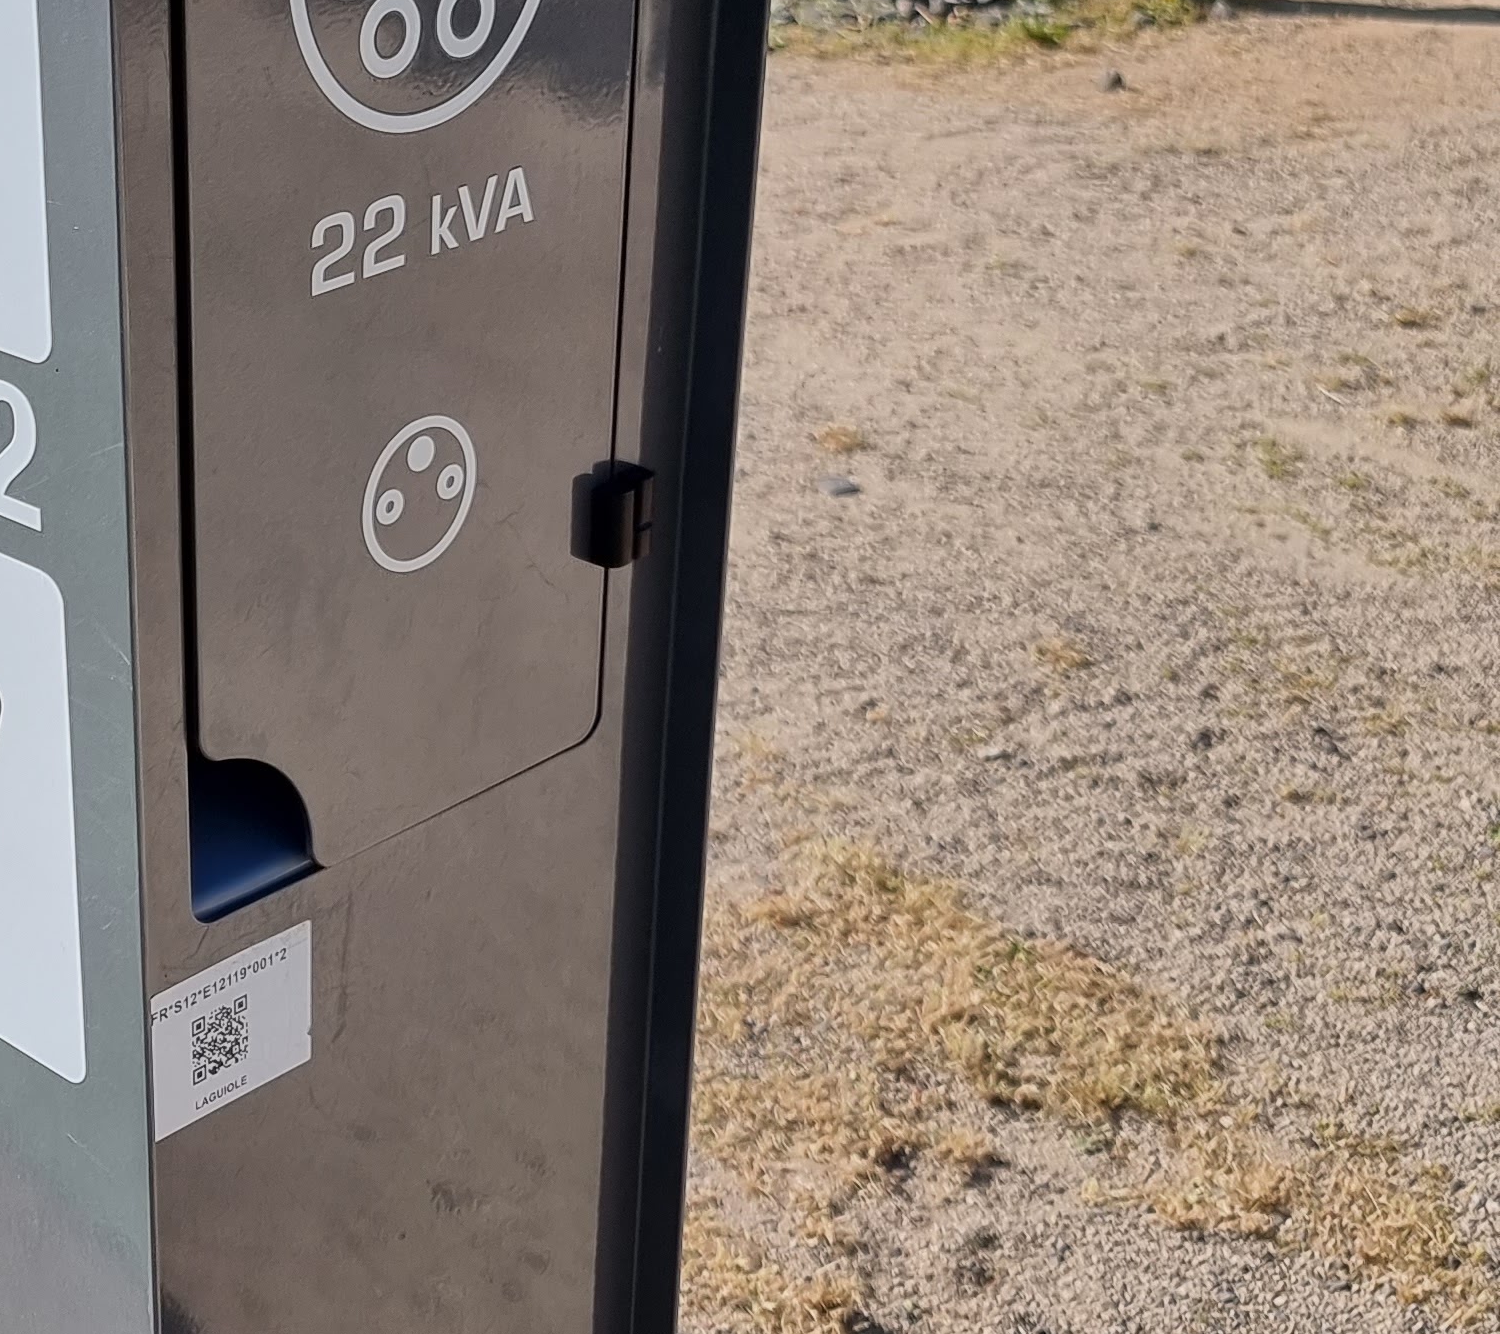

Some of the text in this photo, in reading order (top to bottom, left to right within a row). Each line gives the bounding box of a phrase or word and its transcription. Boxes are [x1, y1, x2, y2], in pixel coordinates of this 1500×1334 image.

[311, 167, 535, 296] 22 kVA
[195, 1075, 248, 1110] LAGUIOLE
